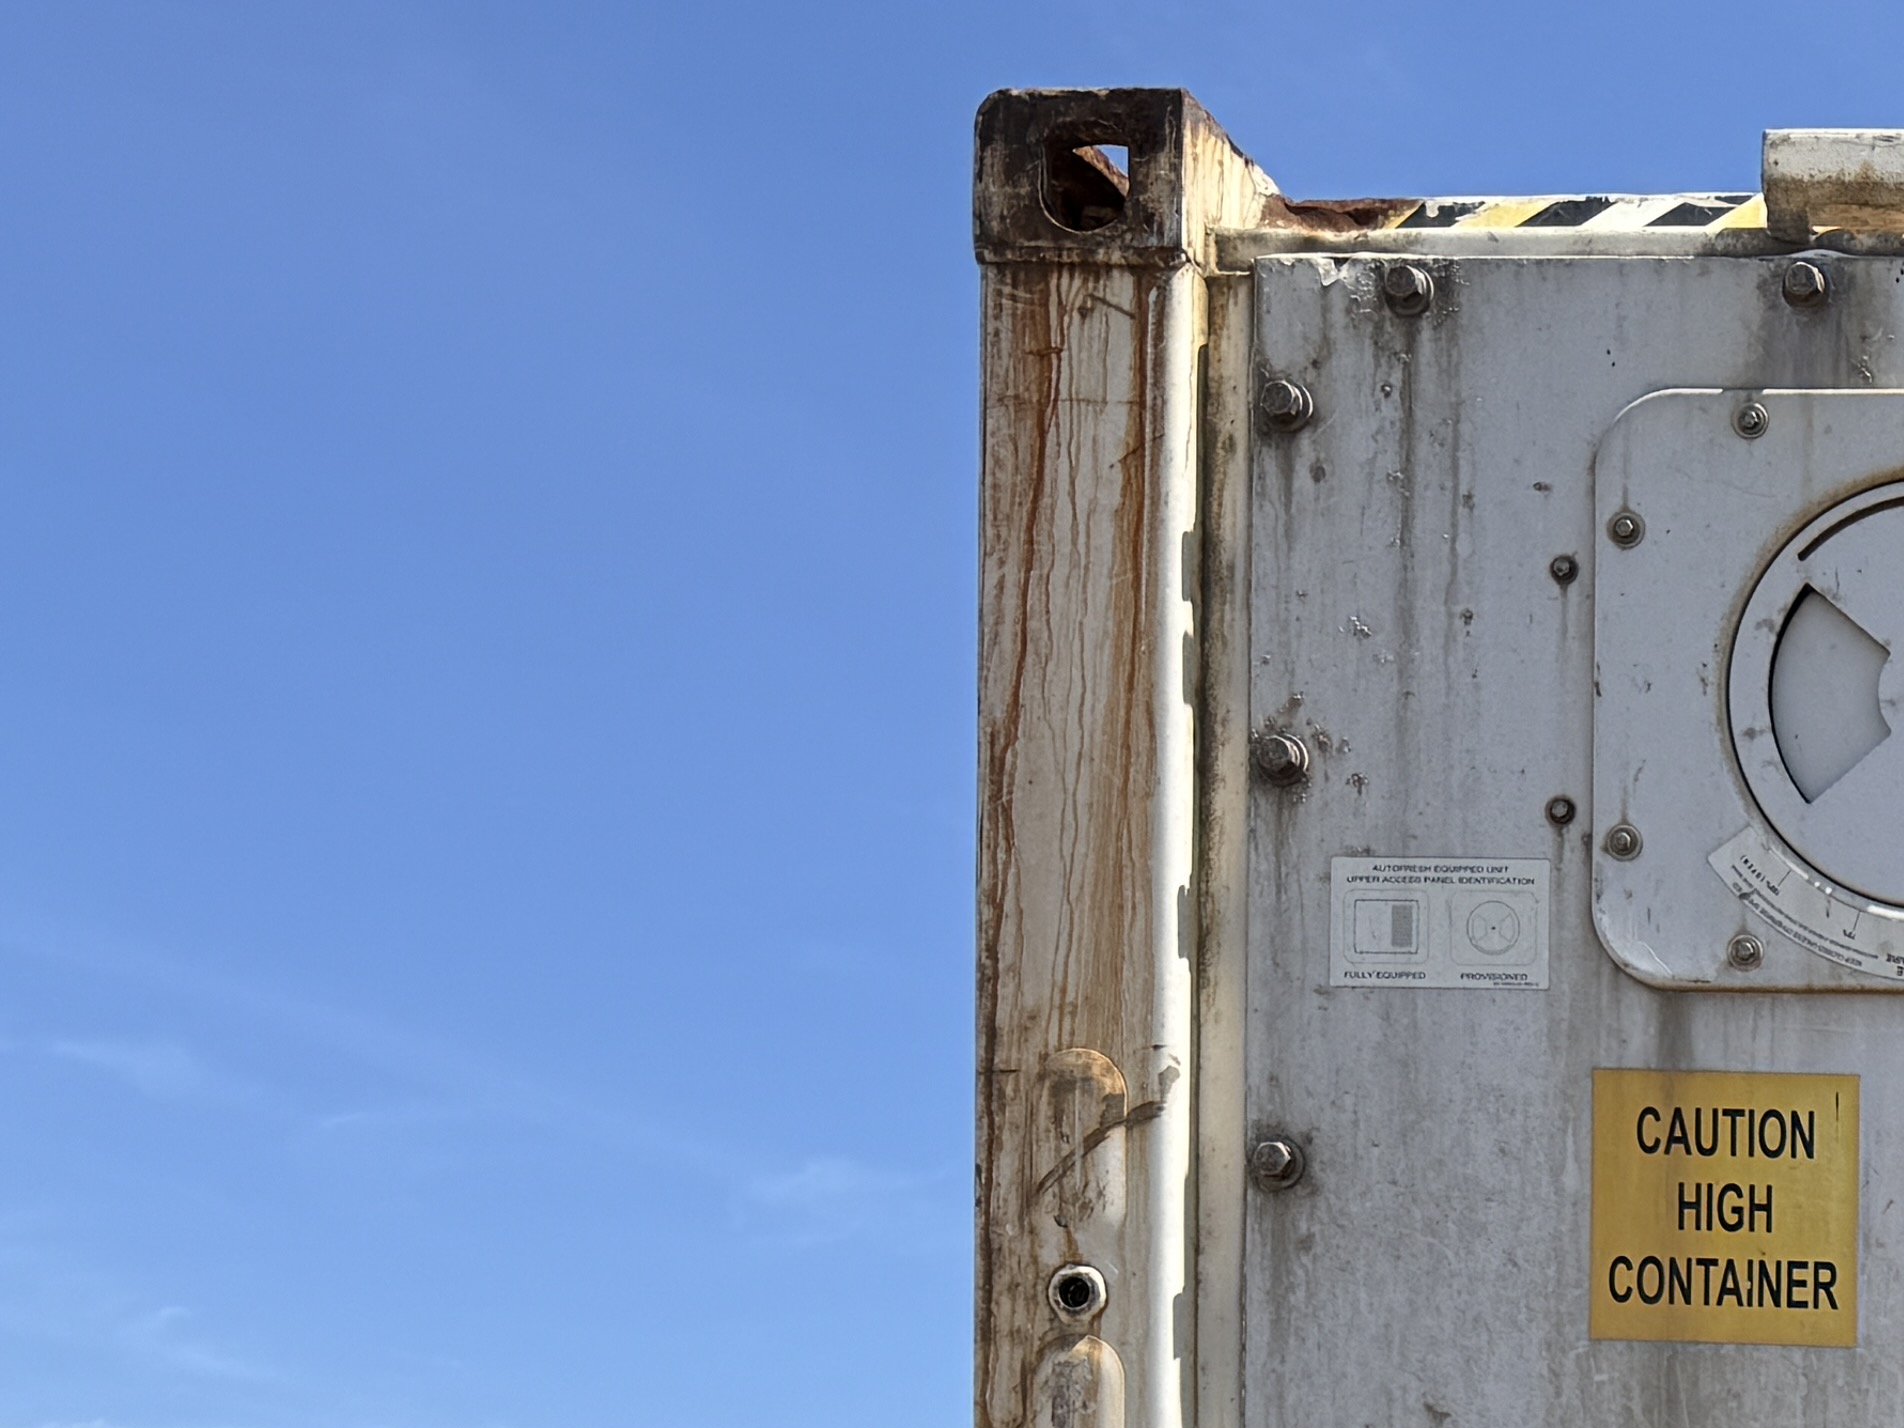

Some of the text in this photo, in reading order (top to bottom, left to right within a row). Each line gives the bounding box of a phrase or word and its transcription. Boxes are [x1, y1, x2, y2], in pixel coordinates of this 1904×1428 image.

[1434, 865, 1485, 873] EQUIPPED
[1487, 865, 1509, 873] UNIT
[1347, 876, 1535, 886] UPPER ACCESS PANEL IDENTIFICATION
[1344, 971, 1426, 980] FULLY EQUIPPED
[1460, 973, 1528, 982] PROVISIONED
[1636, 1106, 1815, 1160] CAUTION
[1678, 1182, 1773, 1233] HIGH
[1608, 1255, 1839, 1310] CONTAINER
